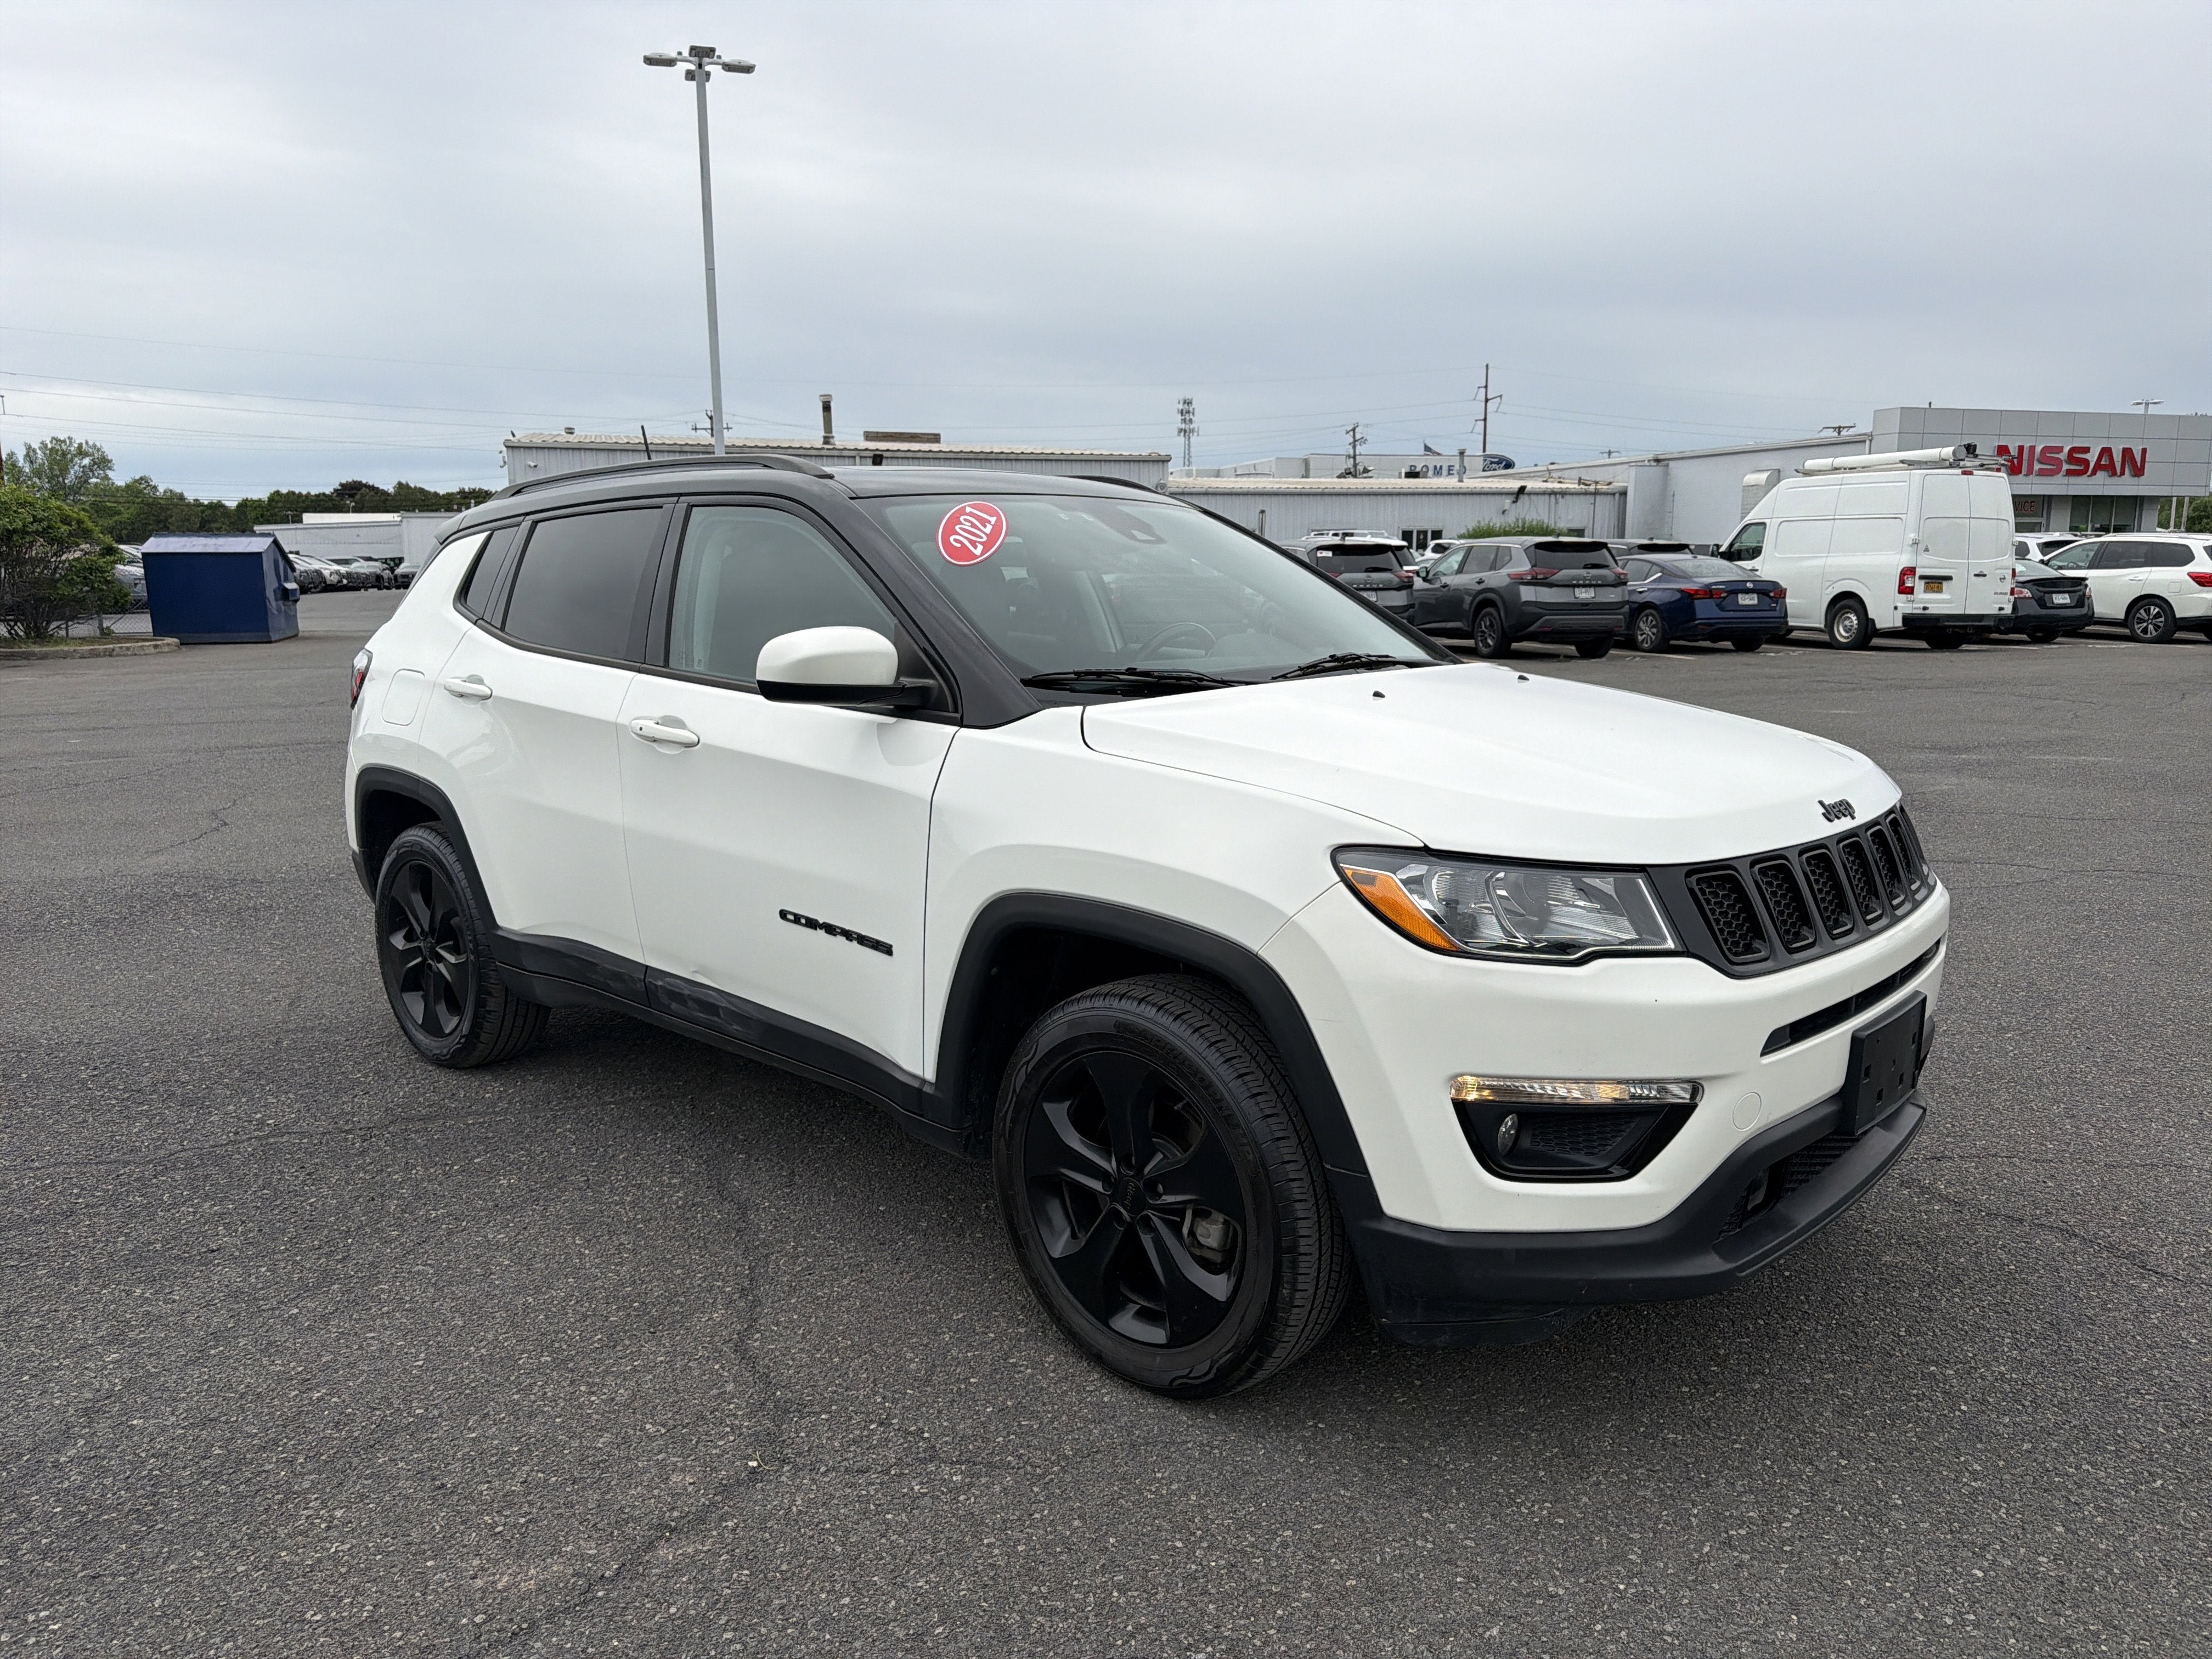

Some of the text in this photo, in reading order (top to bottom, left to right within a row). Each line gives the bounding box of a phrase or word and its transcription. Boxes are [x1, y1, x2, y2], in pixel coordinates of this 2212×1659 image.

[1482, 458, 1506, 471] Ford
[1996, 444, 2147, 477] NISSAN
[2014, 500, 2035, 512] VICE
[949, 506, 997, 556] 2021
[1818, 798, 1856, 822] Jeep
[778, 909, 893, 956] COMPASS
